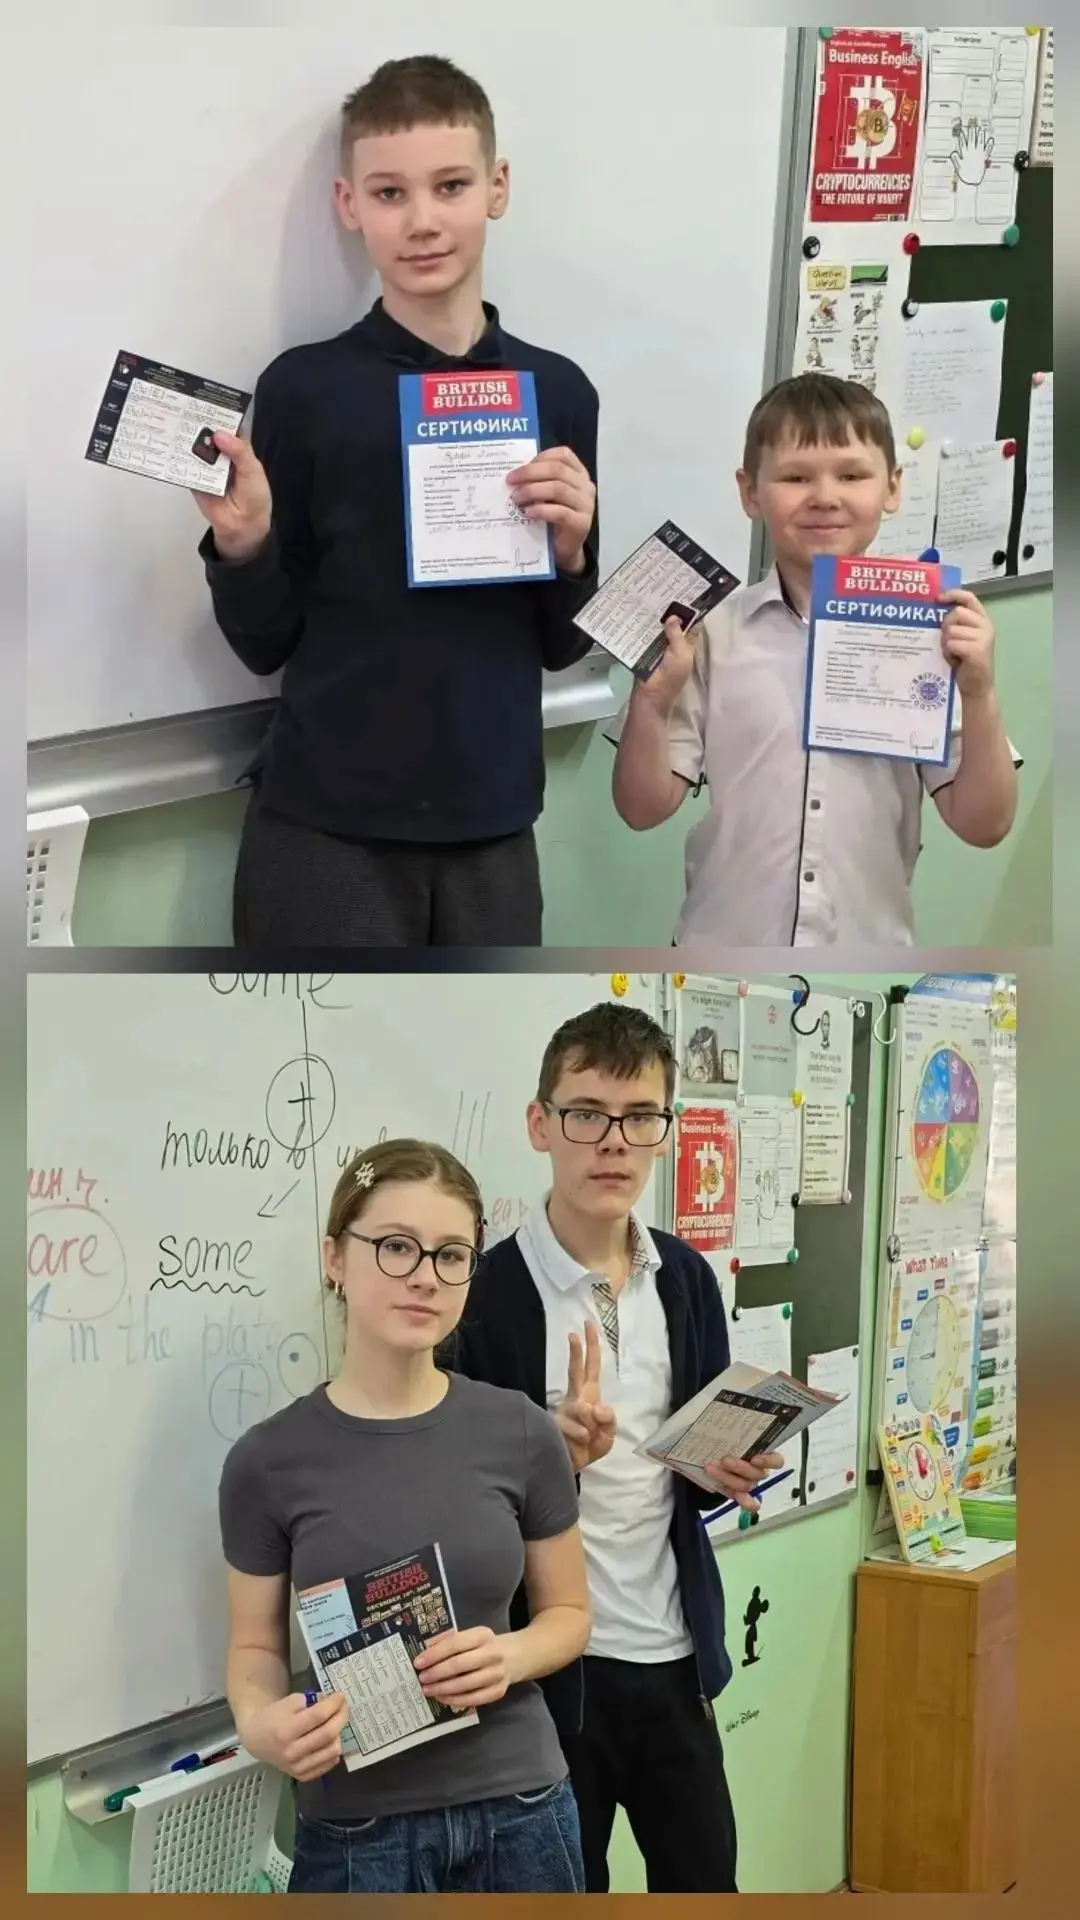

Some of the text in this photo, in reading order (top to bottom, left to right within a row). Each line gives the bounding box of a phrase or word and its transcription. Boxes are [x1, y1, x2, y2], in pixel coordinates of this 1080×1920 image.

[829, 49, 878, 65] Business
[815, 173, 911, 191] CRYPTOCURRENCIES
[821, 193, 835, 205] THE
[838, 193, 864, 205] FUTURE
[867, 193, 876, 205] OF
[437, 381, 508, 394] BRITISH
[432, 394, 513, 408] BULLDOG
[417, 418, 529, 437] СЕРТИФИКАТ
[851, 566, 927, 582] BRITISH
[844, 578, 930, 595] BULLDOG
[825, 600, 948, 622] СЕРТИФИКАТ
[681, 1123, 711, 1133] Business
[161, 1121, 270, 1170] только
[28, 1233, 112, 1278] are
[159, 1234, 256, 1279] some
[118, 1295, 172, 1366] the
